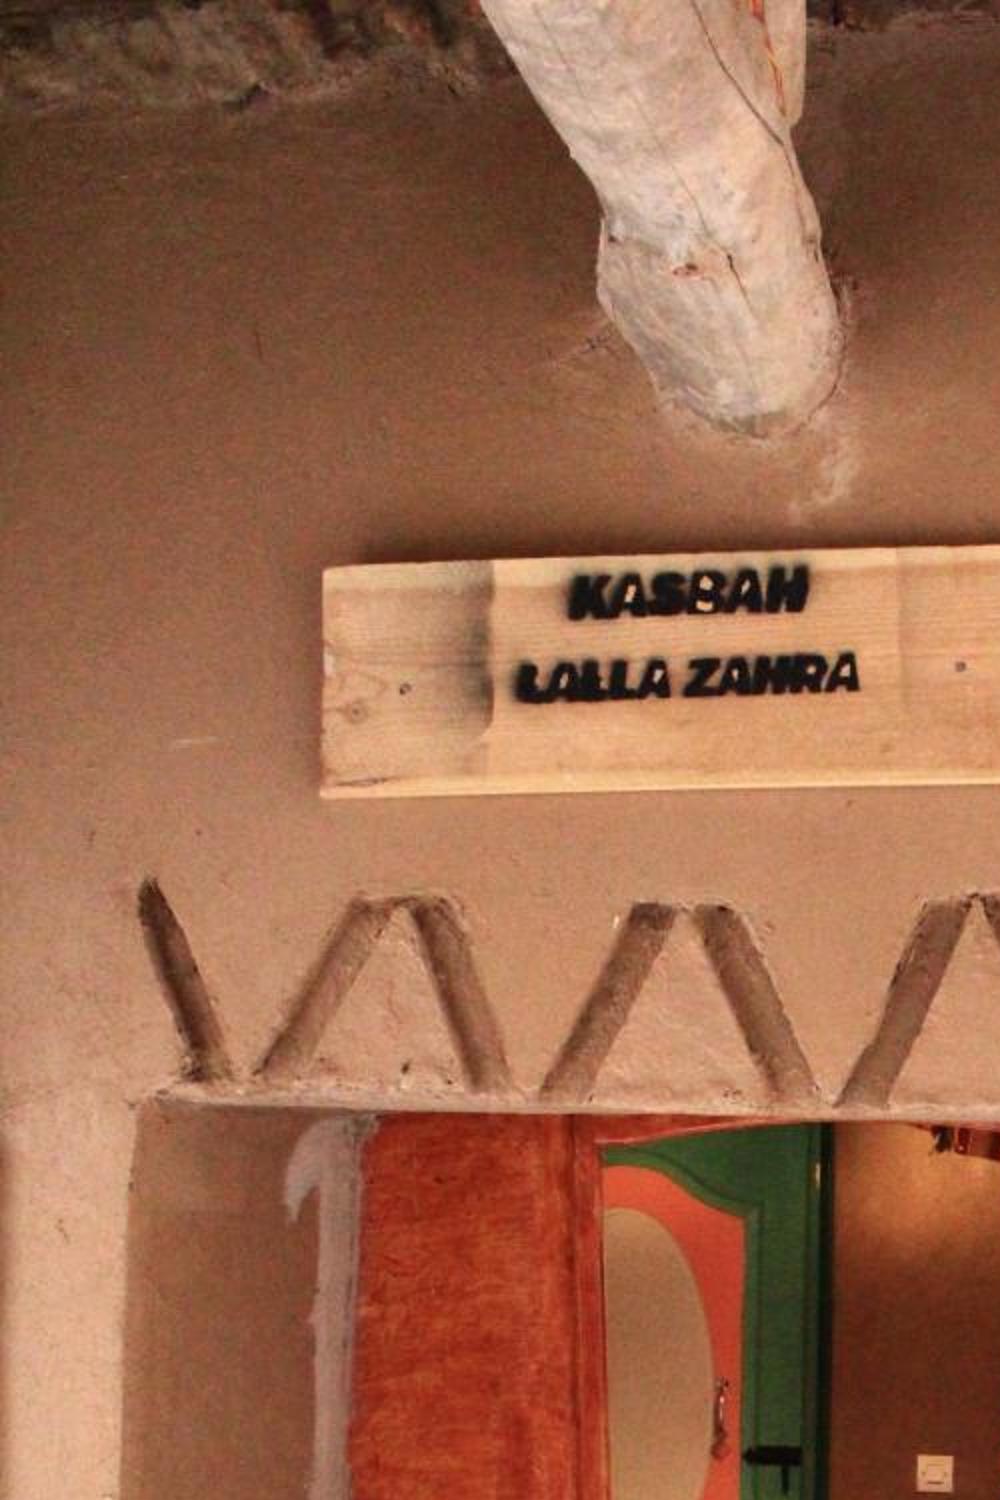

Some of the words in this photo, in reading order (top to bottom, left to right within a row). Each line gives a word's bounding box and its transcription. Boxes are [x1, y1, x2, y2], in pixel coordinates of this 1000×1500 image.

[565, 564, 811, 622] KASBAH
[512, 657, 672, 705] LALLA
[681, 651, 861, 699] ZAHRA
